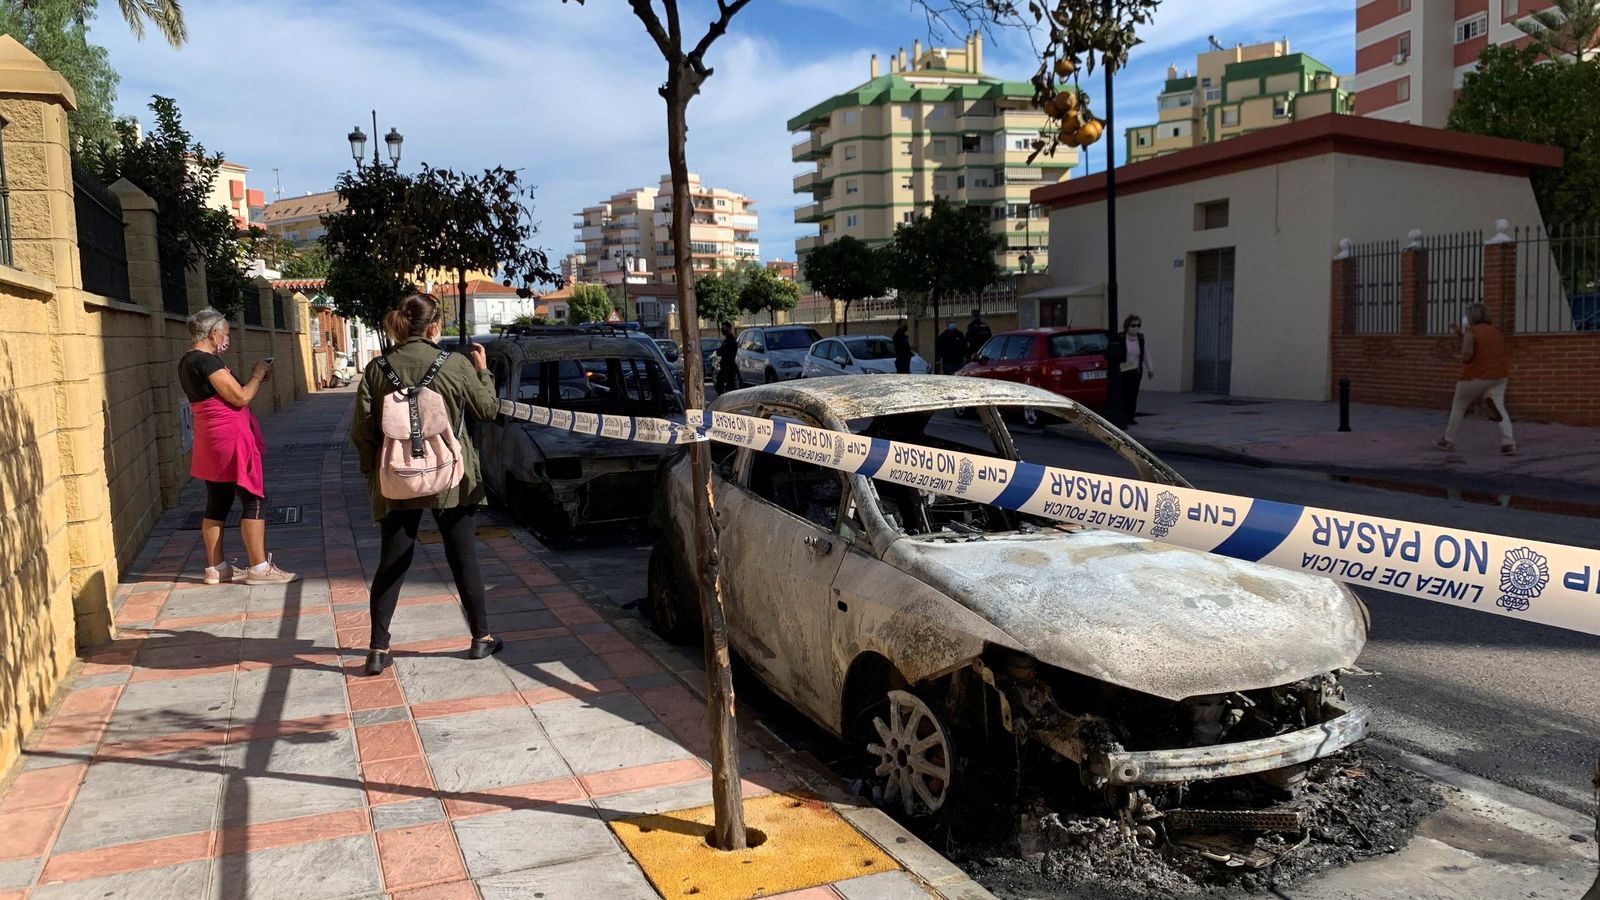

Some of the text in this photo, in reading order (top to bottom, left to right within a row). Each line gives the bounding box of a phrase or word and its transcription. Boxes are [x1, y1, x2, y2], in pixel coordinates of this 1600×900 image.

[387, 371, 401, 387] YLIE
[409, 397, 419, 420] KYLIE
[714, 413, 747, 431] NO PASAR
[757, 424, 771, 436] CNP
[789, 427, 832, 449] NO PASAR
[847, 442, 867, 456] CNP
[787, 446, 807, 458] POLICIA
[814, 452, 831, 463] LINEA
[893, 445, 955, 475] NO PASAR
[889, 468, 953, 492] LINEA DE POLICIA
[978, 465, 1007, 484] CNP
[1050, 472, 1148, 512] NO PASAR
[1043, 500, 1146, 534] LINEA DE POLICIA
[1187, 502, 1236, 527] CNP
[1311, 514, 1421, 563] PASAR
[1434, 534, 1488, 575] NO
[1301, 552, 1379, 582] POLICIA
[1377, 567, 1412, 589] DE
[1415, 574, 1485, 603] LINEA
